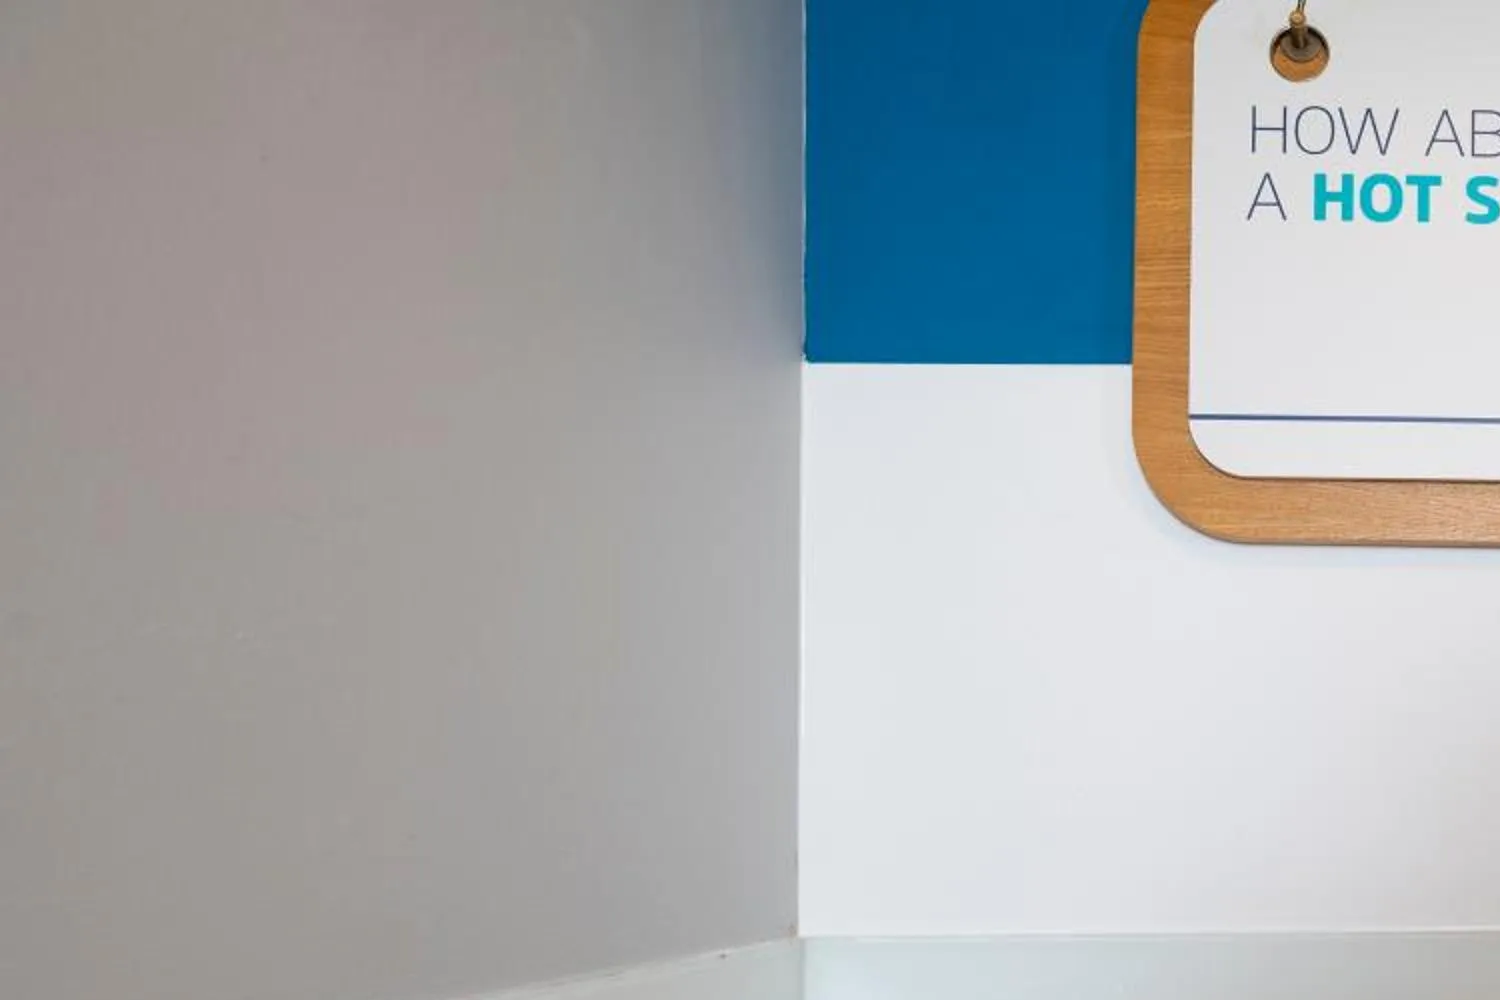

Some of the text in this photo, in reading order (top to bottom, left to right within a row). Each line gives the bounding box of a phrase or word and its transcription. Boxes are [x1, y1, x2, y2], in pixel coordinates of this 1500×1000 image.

[1250, 105, 1400, 156] HOW
[1245, 171, 1288, 221] A
[1312, 172, 1442, 223] HOT
